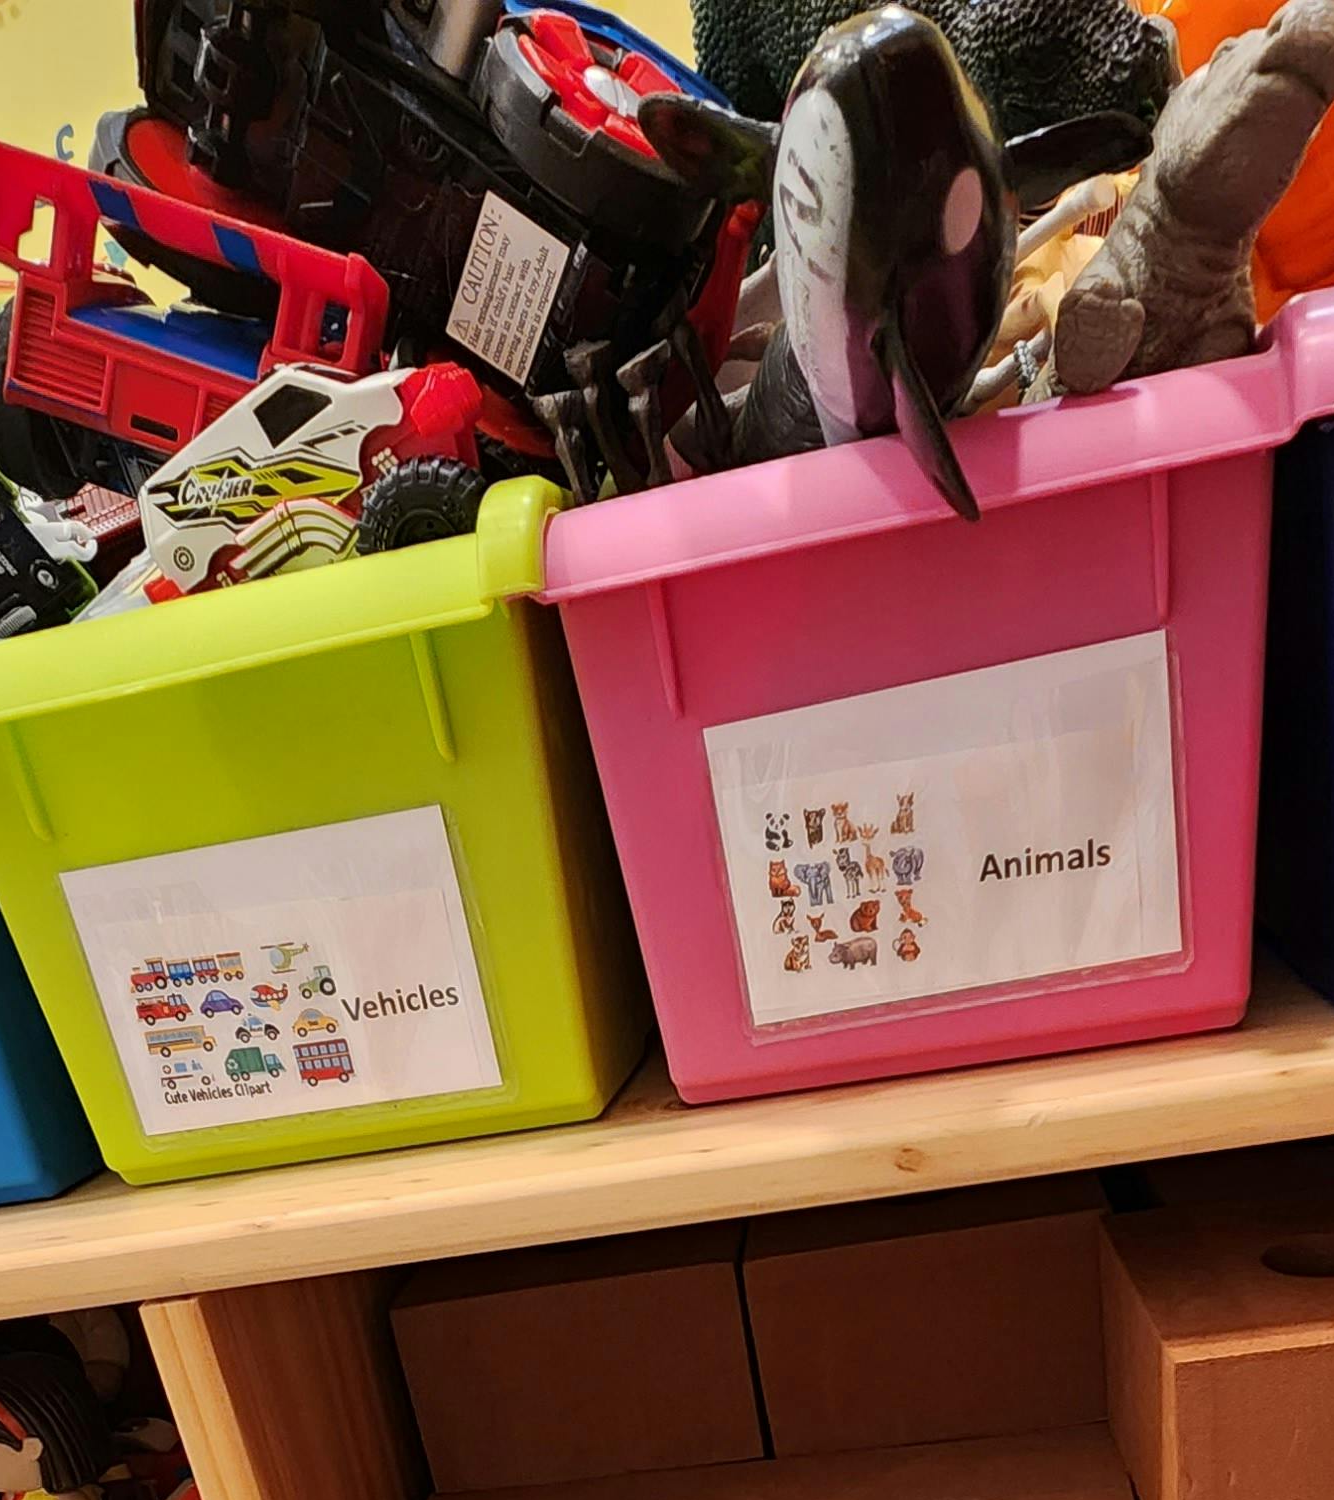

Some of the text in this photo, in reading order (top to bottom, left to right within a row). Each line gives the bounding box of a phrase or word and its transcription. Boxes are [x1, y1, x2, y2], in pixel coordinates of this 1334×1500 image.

[460, 208, 502, 304] CAUTION:
[502, 262, 515, 284] hair
[467, 325, 481, 348] Hair
[498, 233, 510, 258] may
[492, 332, 507, 364] comes
[507, 282, 523, 319] contact
[518, 258, 531, 281] with
[503, 334, 521, 371] moving
[516, 308, 528, 335] parts
[979, 838, 1111, 882] Animals
[341, 984, 460, 1021] Vehicles
[164, 1081, 273, 1105] Cute Vehicles Clipart
